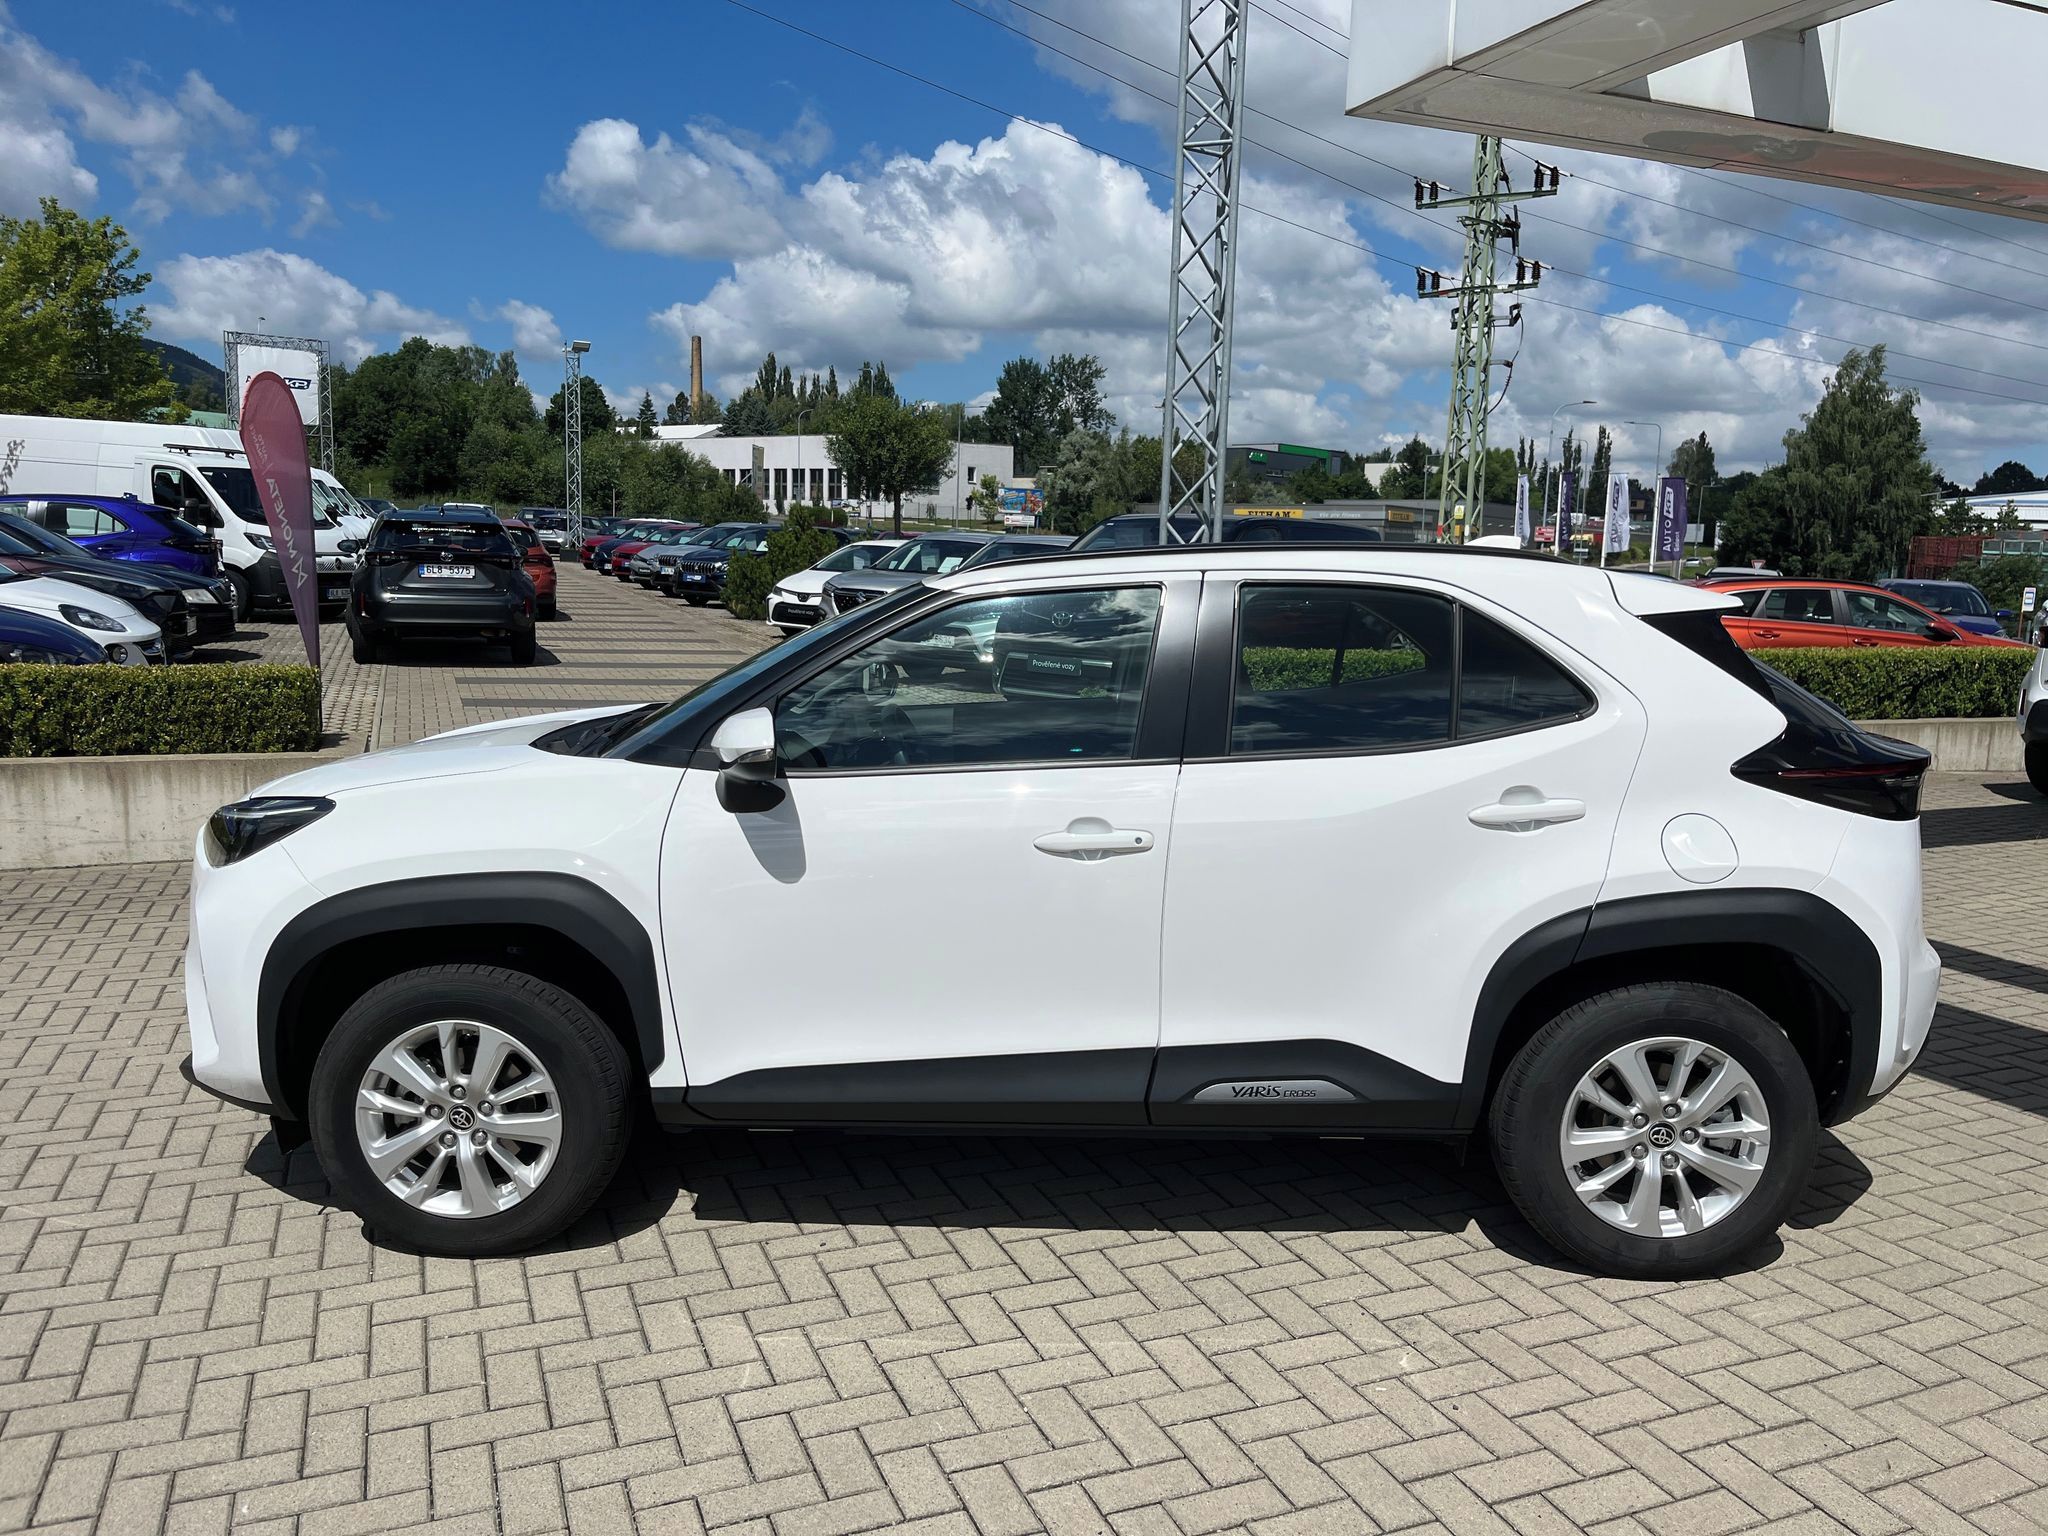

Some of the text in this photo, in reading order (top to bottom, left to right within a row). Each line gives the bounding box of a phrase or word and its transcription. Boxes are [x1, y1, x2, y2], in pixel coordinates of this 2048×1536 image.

[1663, 519, 1672, 552] AUTO
[426, 565, 471, 575] 6L8 5375
[1032, 659, 1076, 671] Prověřené vozy
[1283, 1089, 1317, 1098] CROSS
